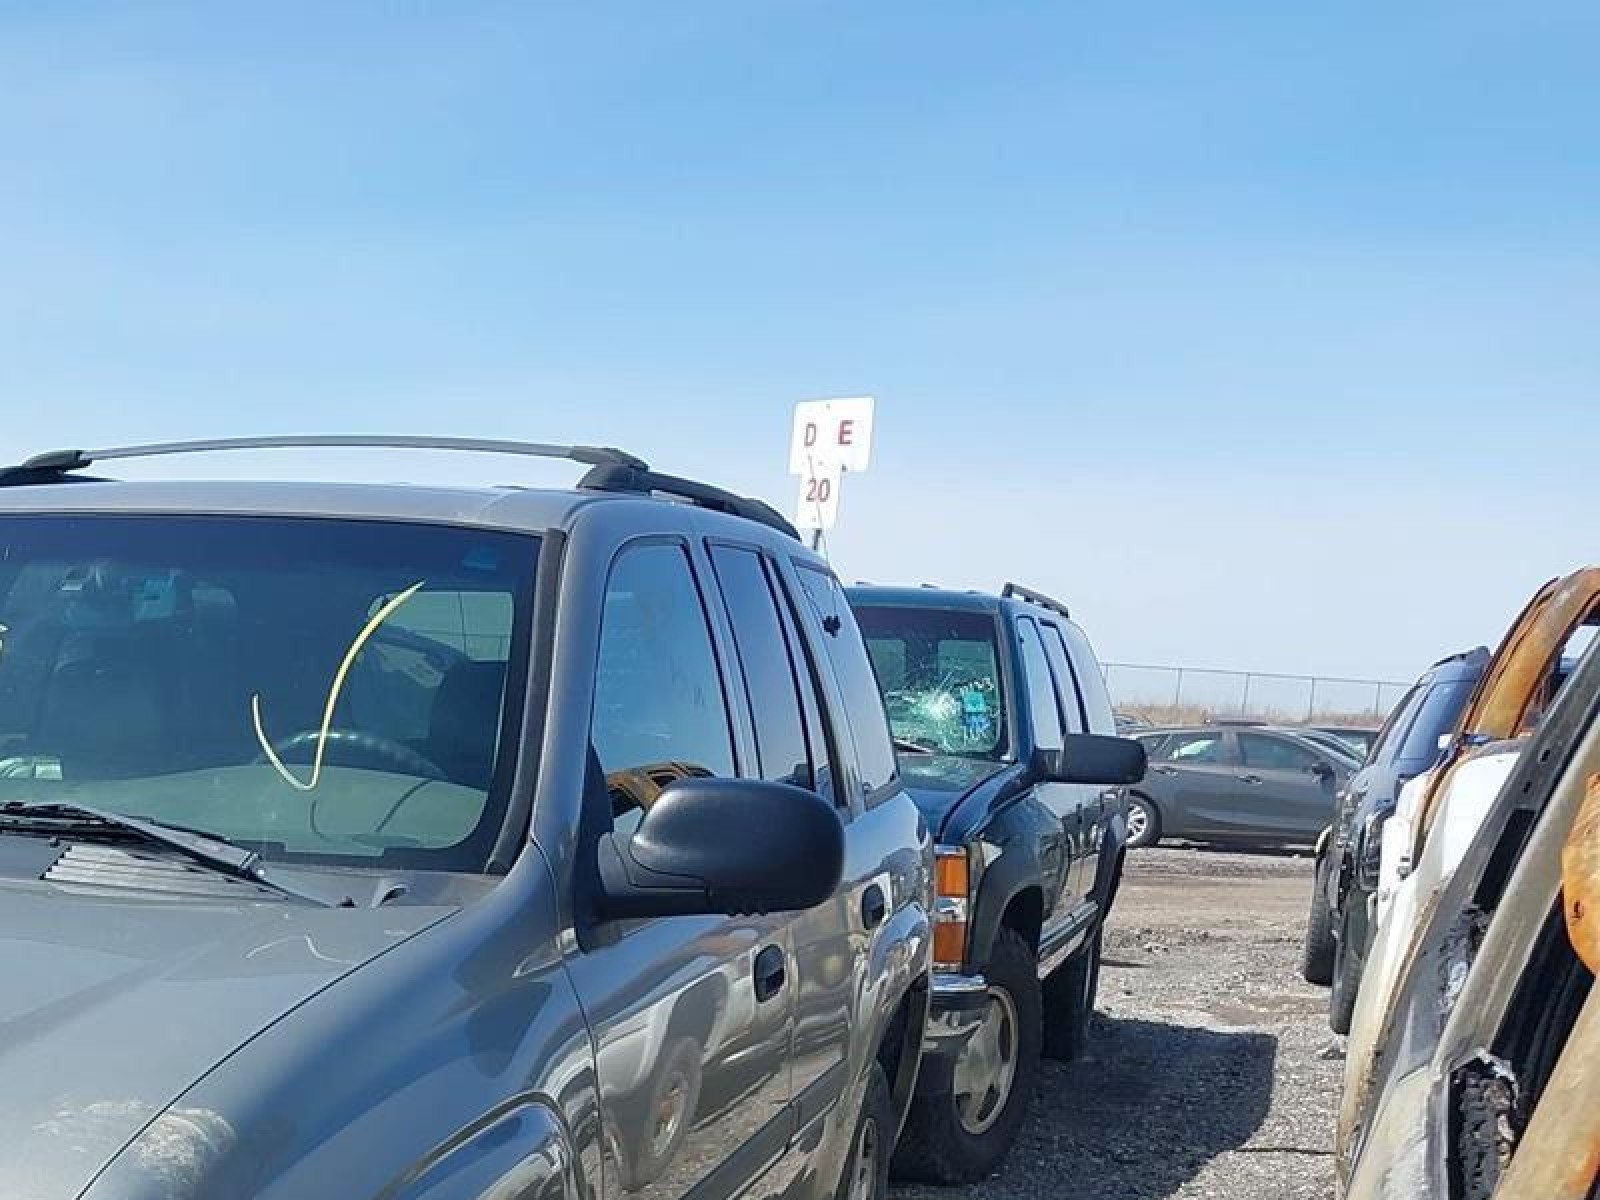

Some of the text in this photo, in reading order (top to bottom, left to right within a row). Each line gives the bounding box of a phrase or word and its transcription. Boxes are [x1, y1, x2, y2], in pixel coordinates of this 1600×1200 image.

[804, 420, 854, 446] D E
[806, 478, 831, 502] 20
